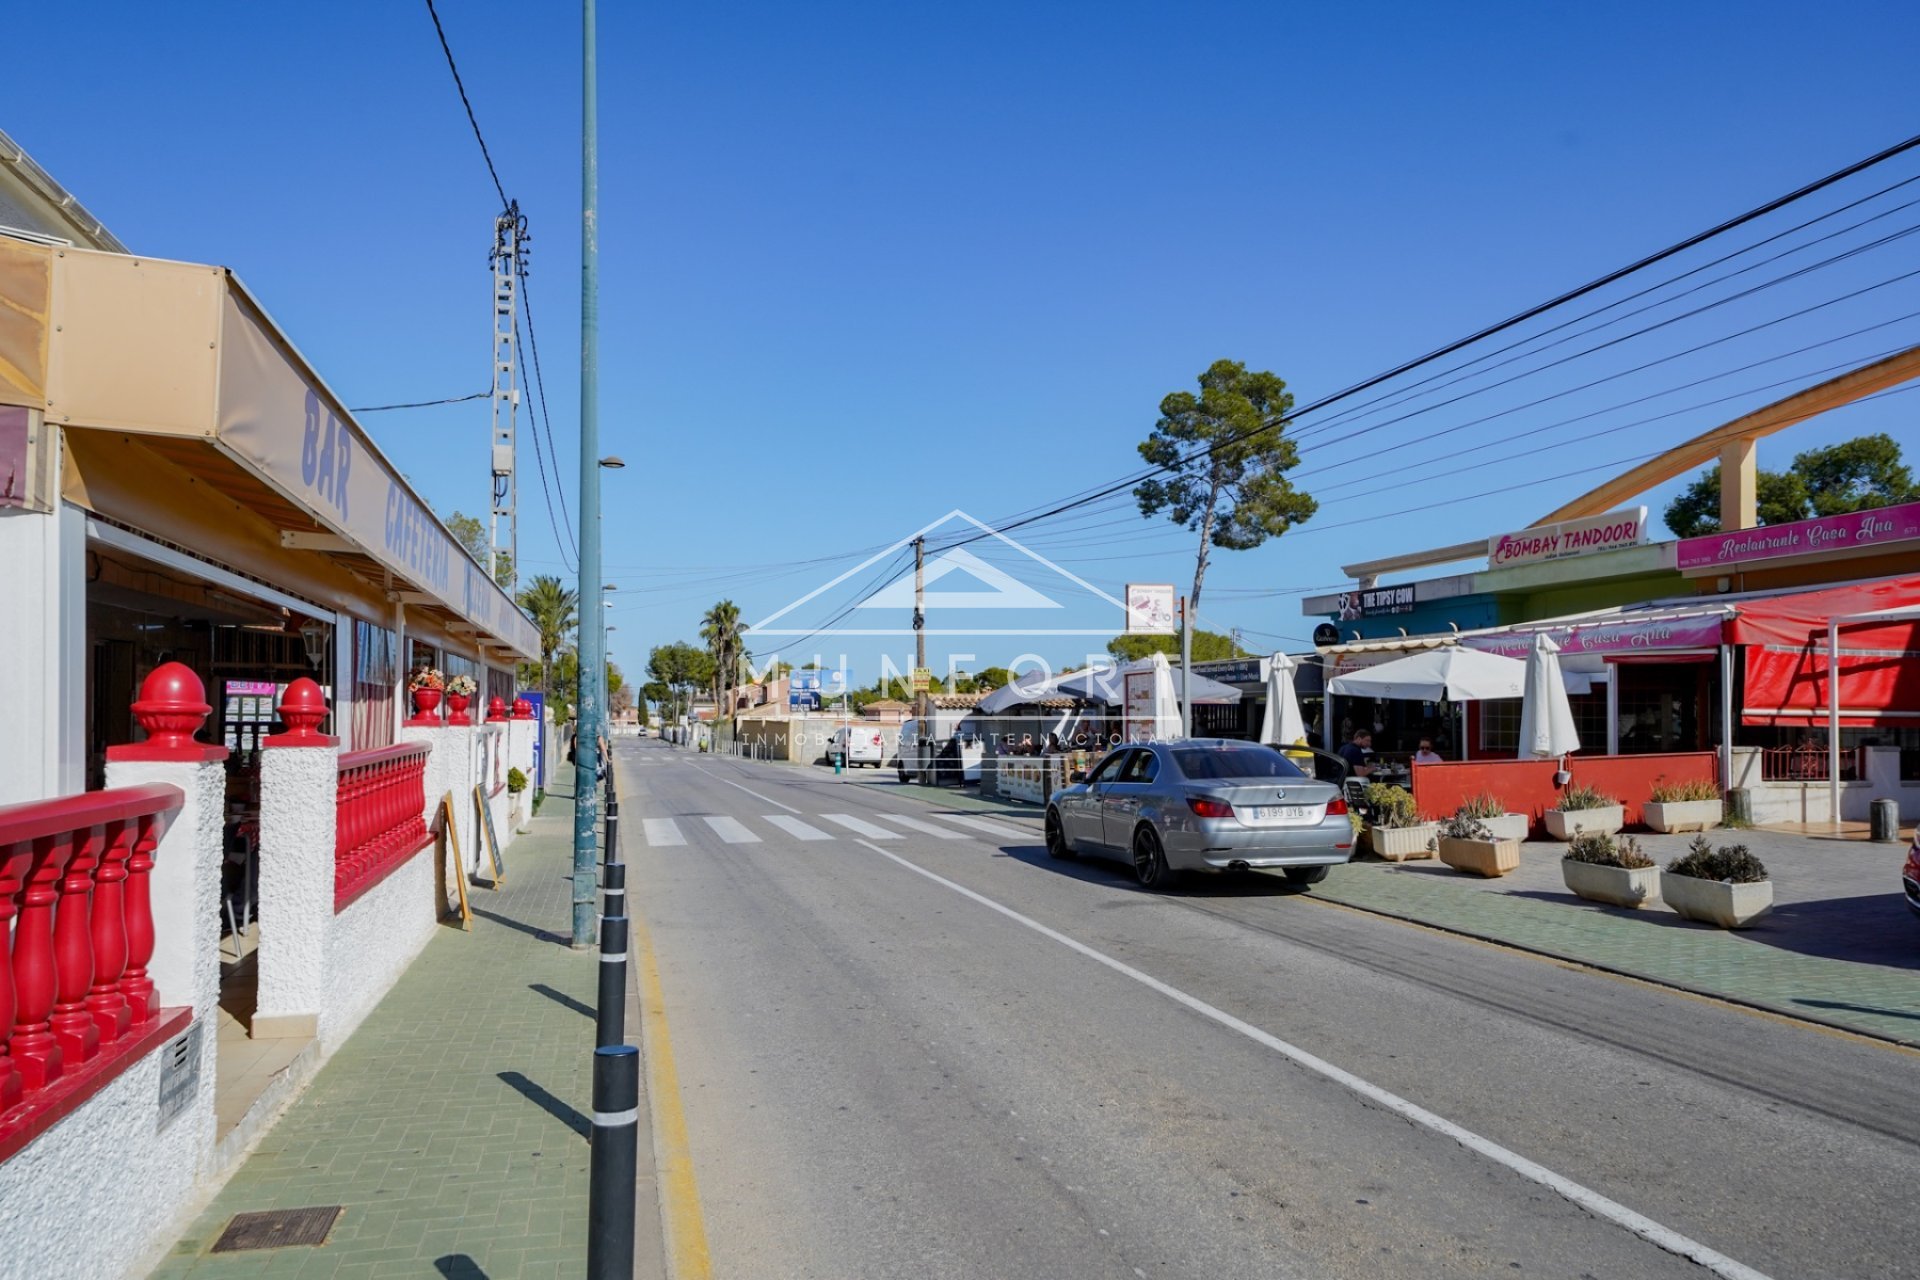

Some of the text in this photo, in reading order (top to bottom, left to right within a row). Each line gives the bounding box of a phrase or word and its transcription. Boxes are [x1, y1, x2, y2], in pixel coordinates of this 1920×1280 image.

[302, 387, 449, 595] BAR CAFETERIA
[1504, 521, 1638, 560] BOMBAY TANDOORI
[1718, 516, 1893, 560] Restaurante Casa Ana
[1363, 587, 1414, 608] THE TIPSY COW
[1581, 634, 1620, 649] Casa
[1631, 628, 1671, 647] Ana
